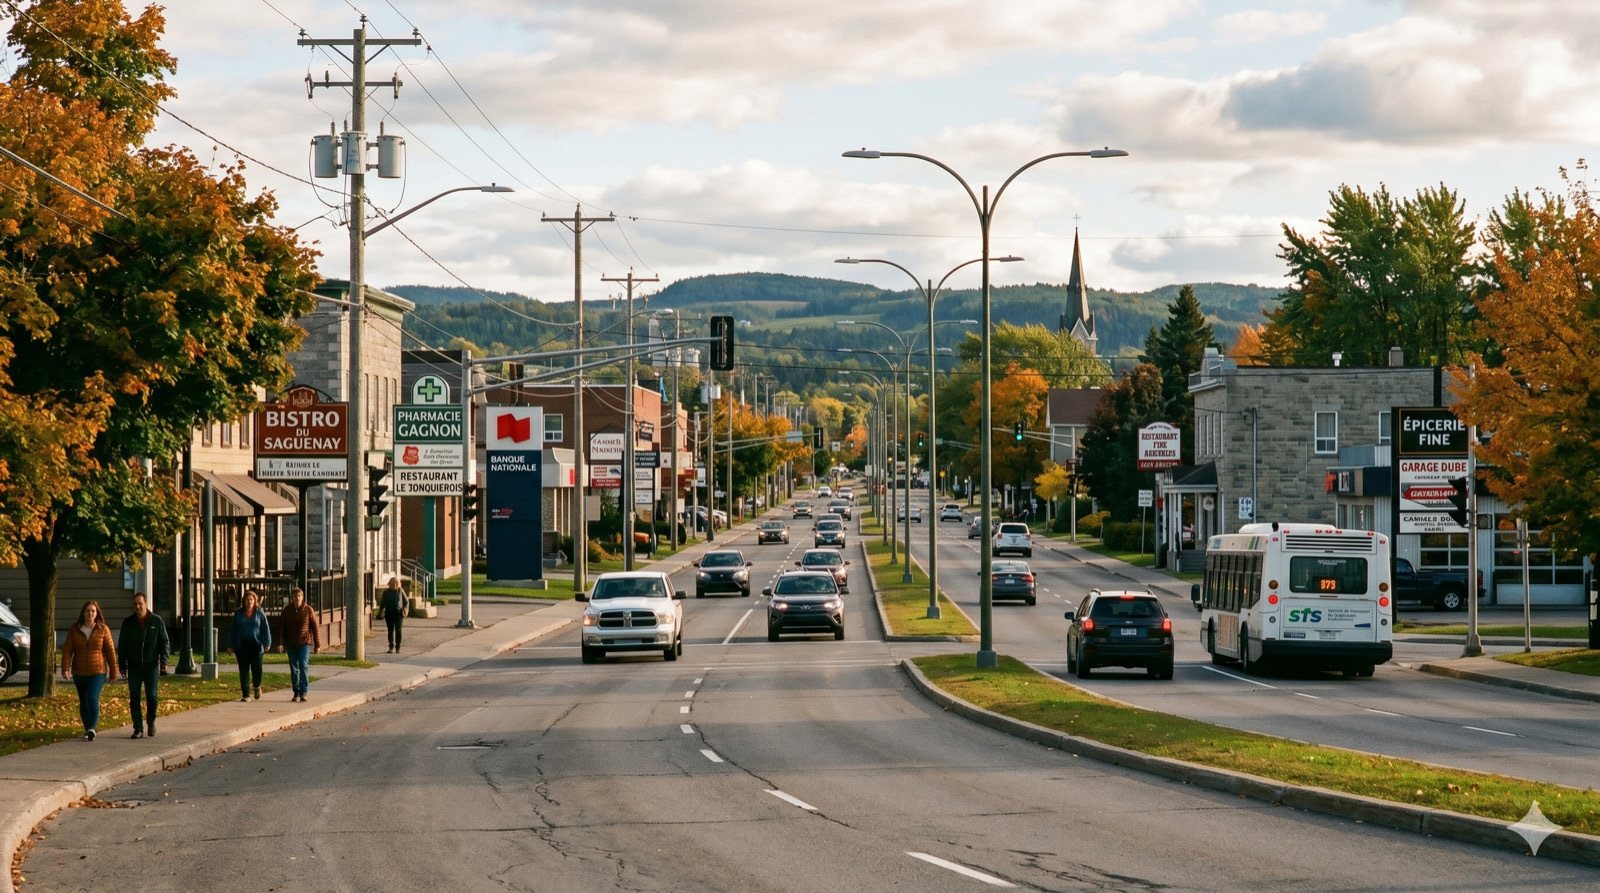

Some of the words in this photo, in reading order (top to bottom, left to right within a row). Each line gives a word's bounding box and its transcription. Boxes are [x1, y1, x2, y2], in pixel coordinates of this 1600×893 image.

[266, 411, 340, 427] BISTRO
[398, 411, 461, 422] PHARMACIE
[1403, 416, 1466, 431] ÉPICERIE
[296, 428, 309, 437] DU
[398, 424, 461, 437] GAGNON
[264, 437, 342, 449] SAGUENAY
[1419, 434, 1450, 445] FINE
[491, 456, 525, 464] BANQUE
[491, 463, 537, 472] NATIONALE
[1401, 462, 1438, 472] GARAGE
[1441, 462, 1467, 472] DUBE
[400, 472, 458, 481] RESTAURANT
[396, 483, 406, 492] LE
[408, 483, 463, 493] JONQUIEROIS
